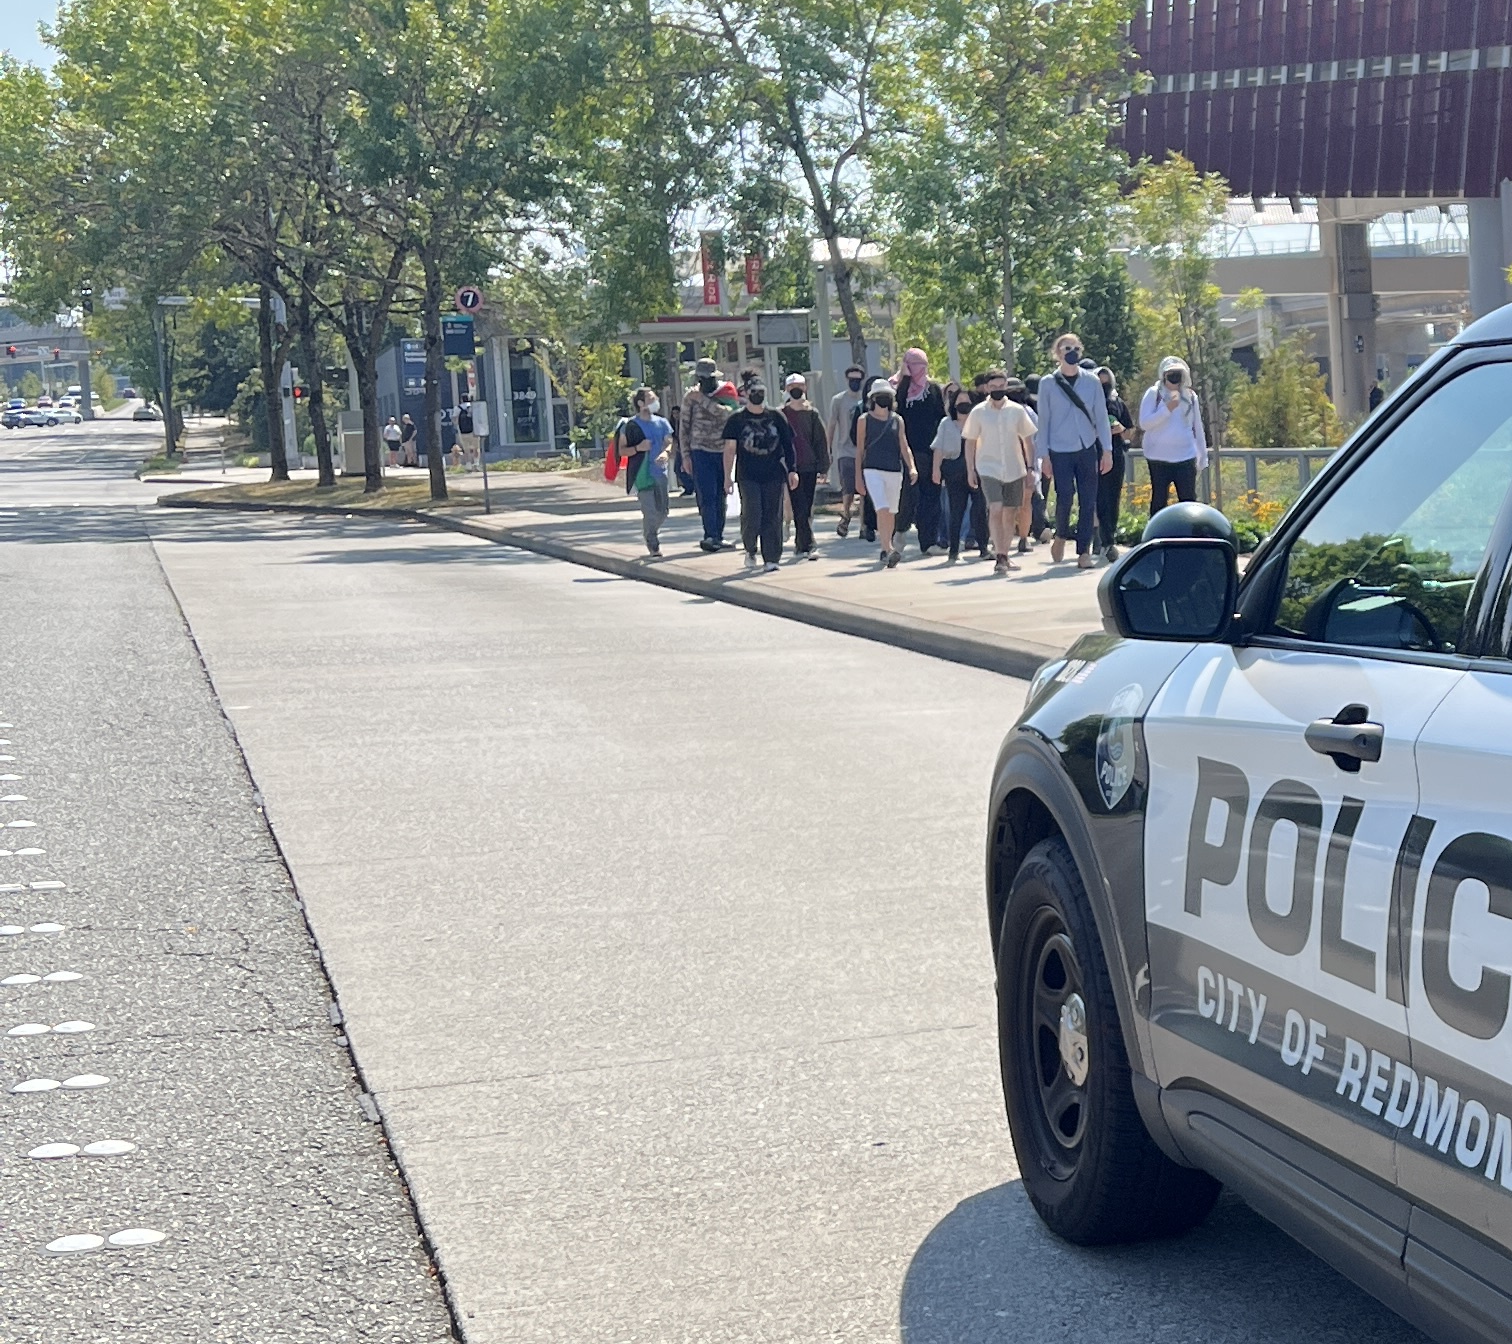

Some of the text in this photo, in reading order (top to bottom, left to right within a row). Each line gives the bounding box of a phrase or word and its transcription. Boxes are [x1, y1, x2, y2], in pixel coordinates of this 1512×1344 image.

[463, 291, 475, 307] 7
[1197, 965, 1267, 1045] CITY
[1280, 1008, 1327, 1076] OF
